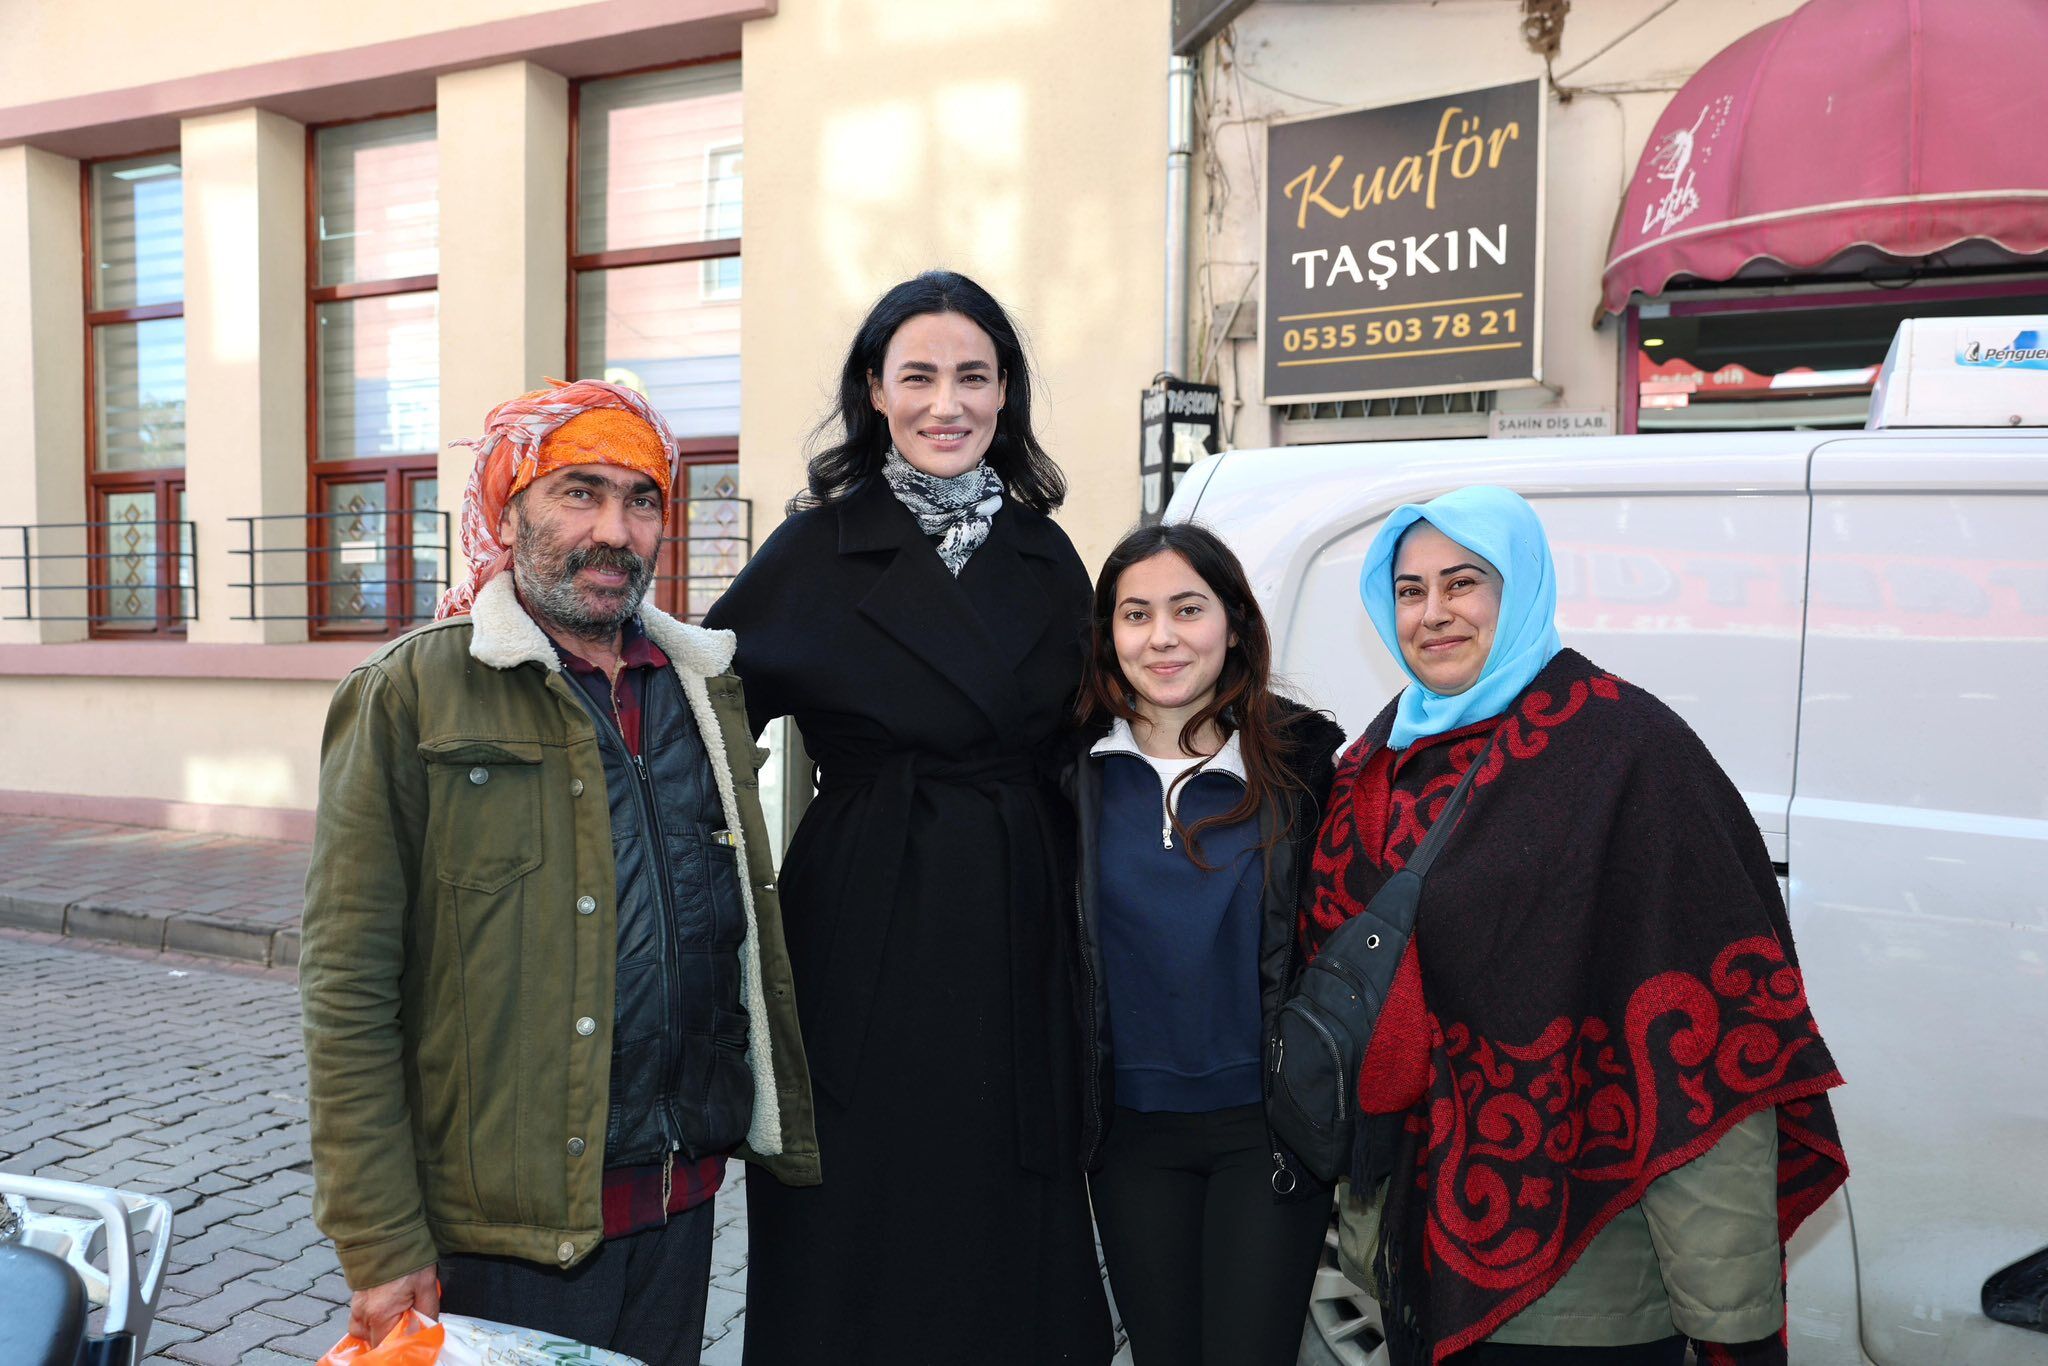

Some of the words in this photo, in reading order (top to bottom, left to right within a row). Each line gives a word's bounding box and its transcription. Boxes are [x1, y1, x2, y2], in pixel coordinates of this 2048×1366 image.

[1284, 107, 1519, 229] Kuaför
[1292, 224, 1508, 291] TAŞKIN
[1283, 324, 1357, 352] 0535
[1365, 317, 1422, 345] 503
[1432, 313, 1471, 339] 78
[1480, 308, 1517, 335] 21
[1984, 348, 2048, 362] Pengue
